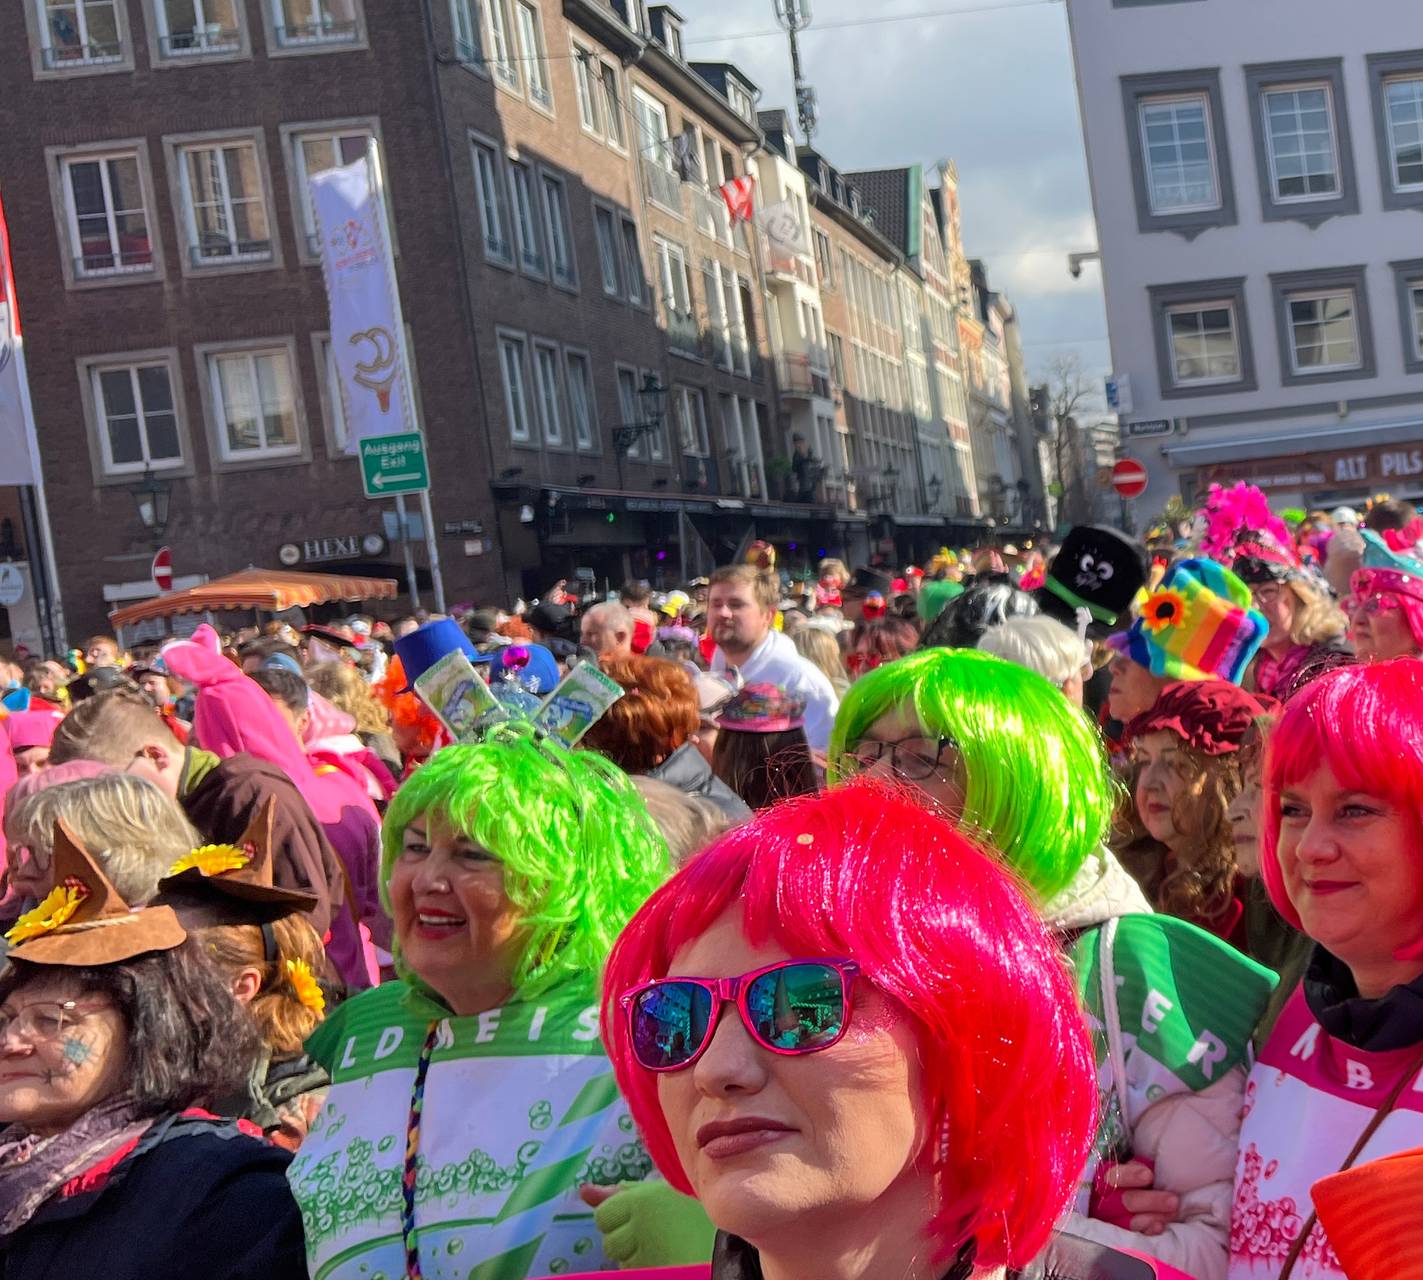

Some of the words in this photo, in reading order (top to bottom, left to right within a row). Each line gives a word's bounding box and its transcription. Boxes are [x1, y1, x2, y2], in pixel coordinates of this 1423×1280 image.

[365, 439, 420, 458] Ausgang
[381, 454, 407, 470] Exit
[1334, 455, 1368, 481] ALT
[1114, 976, 1227, 1080] ER
